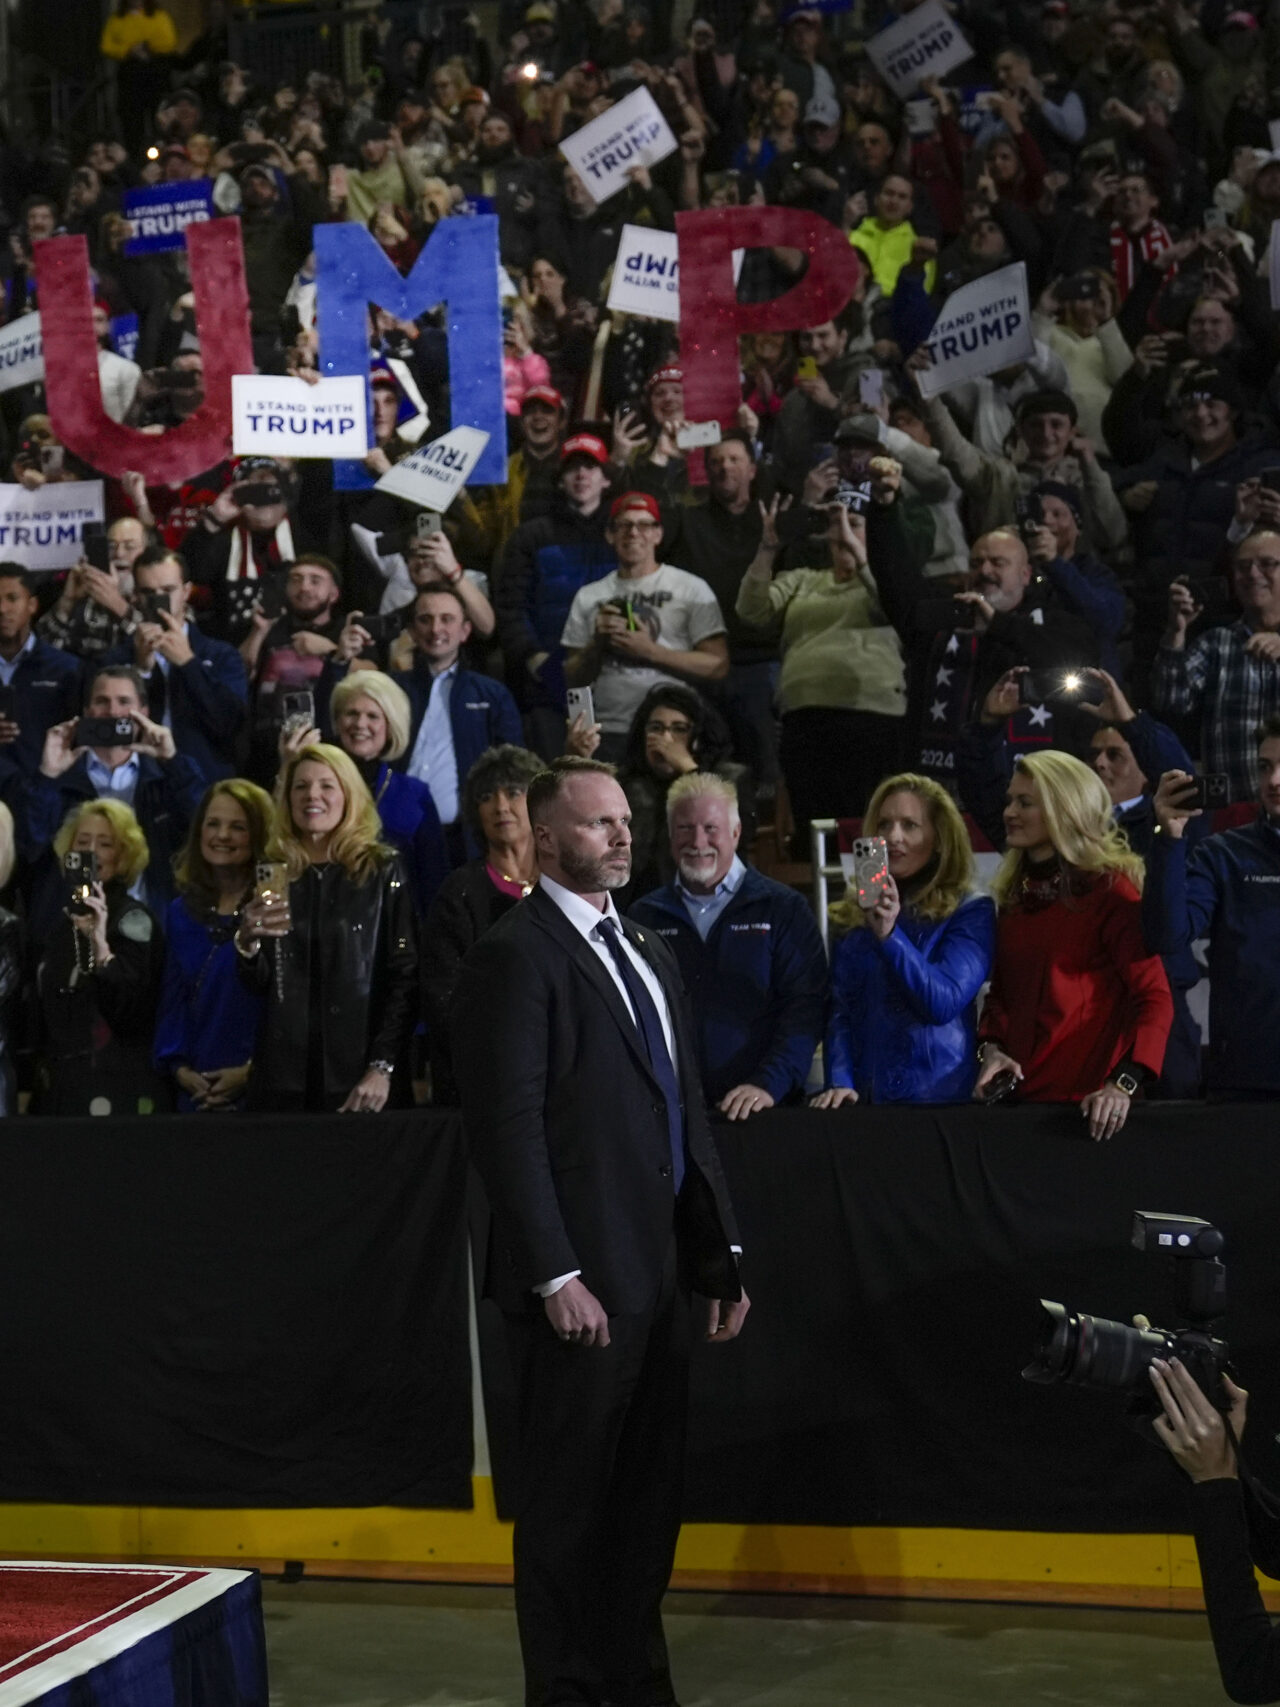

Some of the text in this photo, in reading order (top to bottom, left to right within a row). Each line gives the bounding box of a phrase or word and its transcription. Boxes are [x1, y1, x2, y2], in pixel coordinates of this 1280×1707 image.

[885, 29, 954, 81] TRUMP
[586, 122, 661, 179] TRUMP
[587, 131, 624, 160] STAND
[134, 202, 174, 217] STAND
[176, 199, 208, 211] WITH
[931, 296, 1018, 337] STAND WITH
[928, 312, 1022, 366] TRUMP
[256, 401, 307, 413] STAND
[315, 402, 354, 413] WITH
[246, 414, 355, 435] TRUMP
[421, 465, 451, 481] STAND
[4, 510, 51, 522] STAND
[59, 508, 95, 521] WITH
[921, 749, 954, 768] 2024
